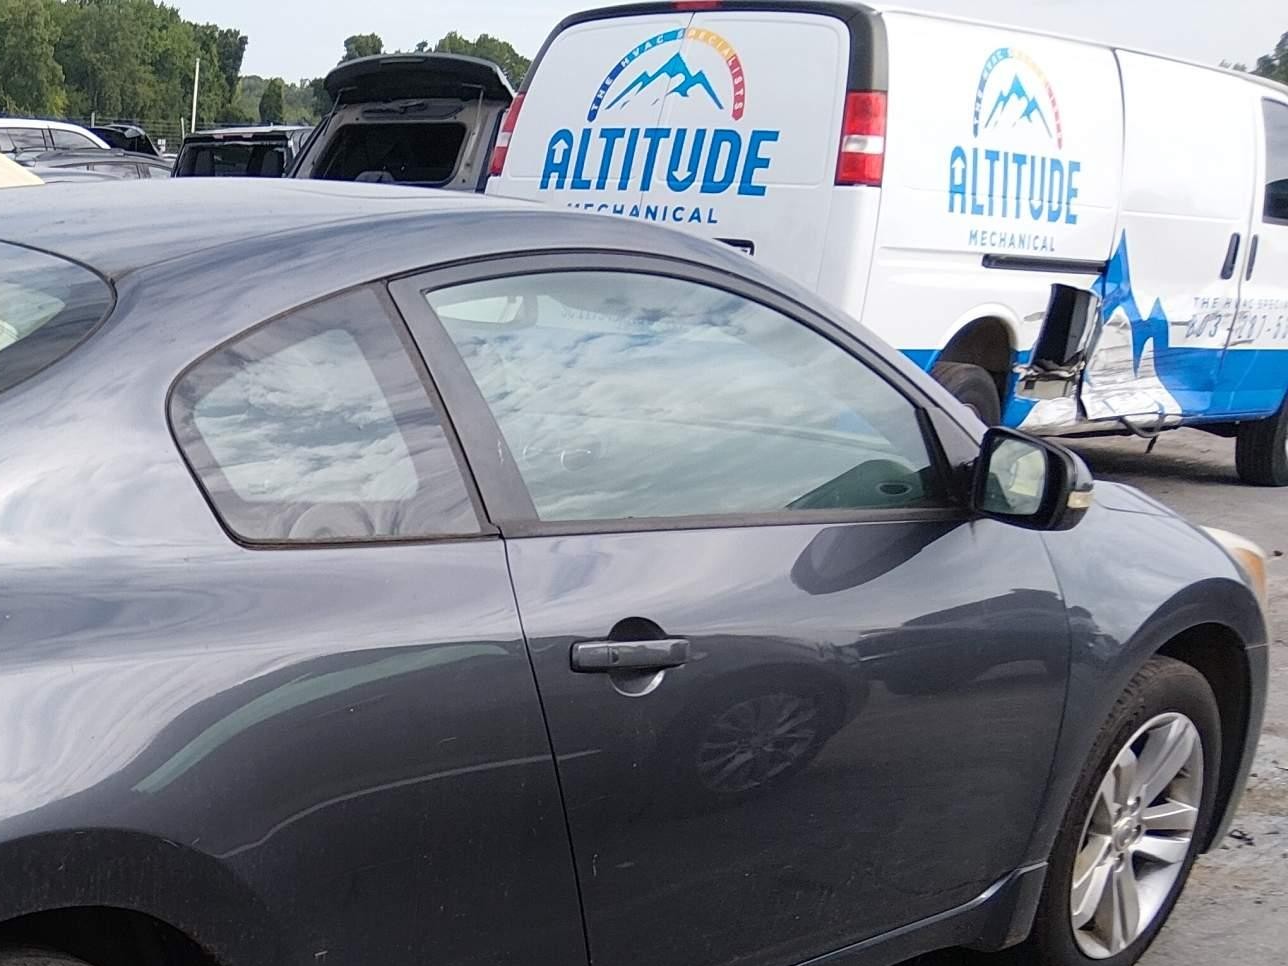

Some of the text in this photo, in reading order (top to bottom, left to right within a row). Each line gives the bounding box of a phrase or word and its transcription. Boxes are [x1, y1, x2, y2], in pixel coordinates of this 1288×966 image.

[591, 28, 744, 112] THE HVAC SPECIALISTS
[539, 127, 780, 197] ALTITUDE
[948, 145, 1081, 225] ALTITUDE
[567, 202, 720, 225] HANICAL
[968, 229, 1055, 252] MECHANICAL
